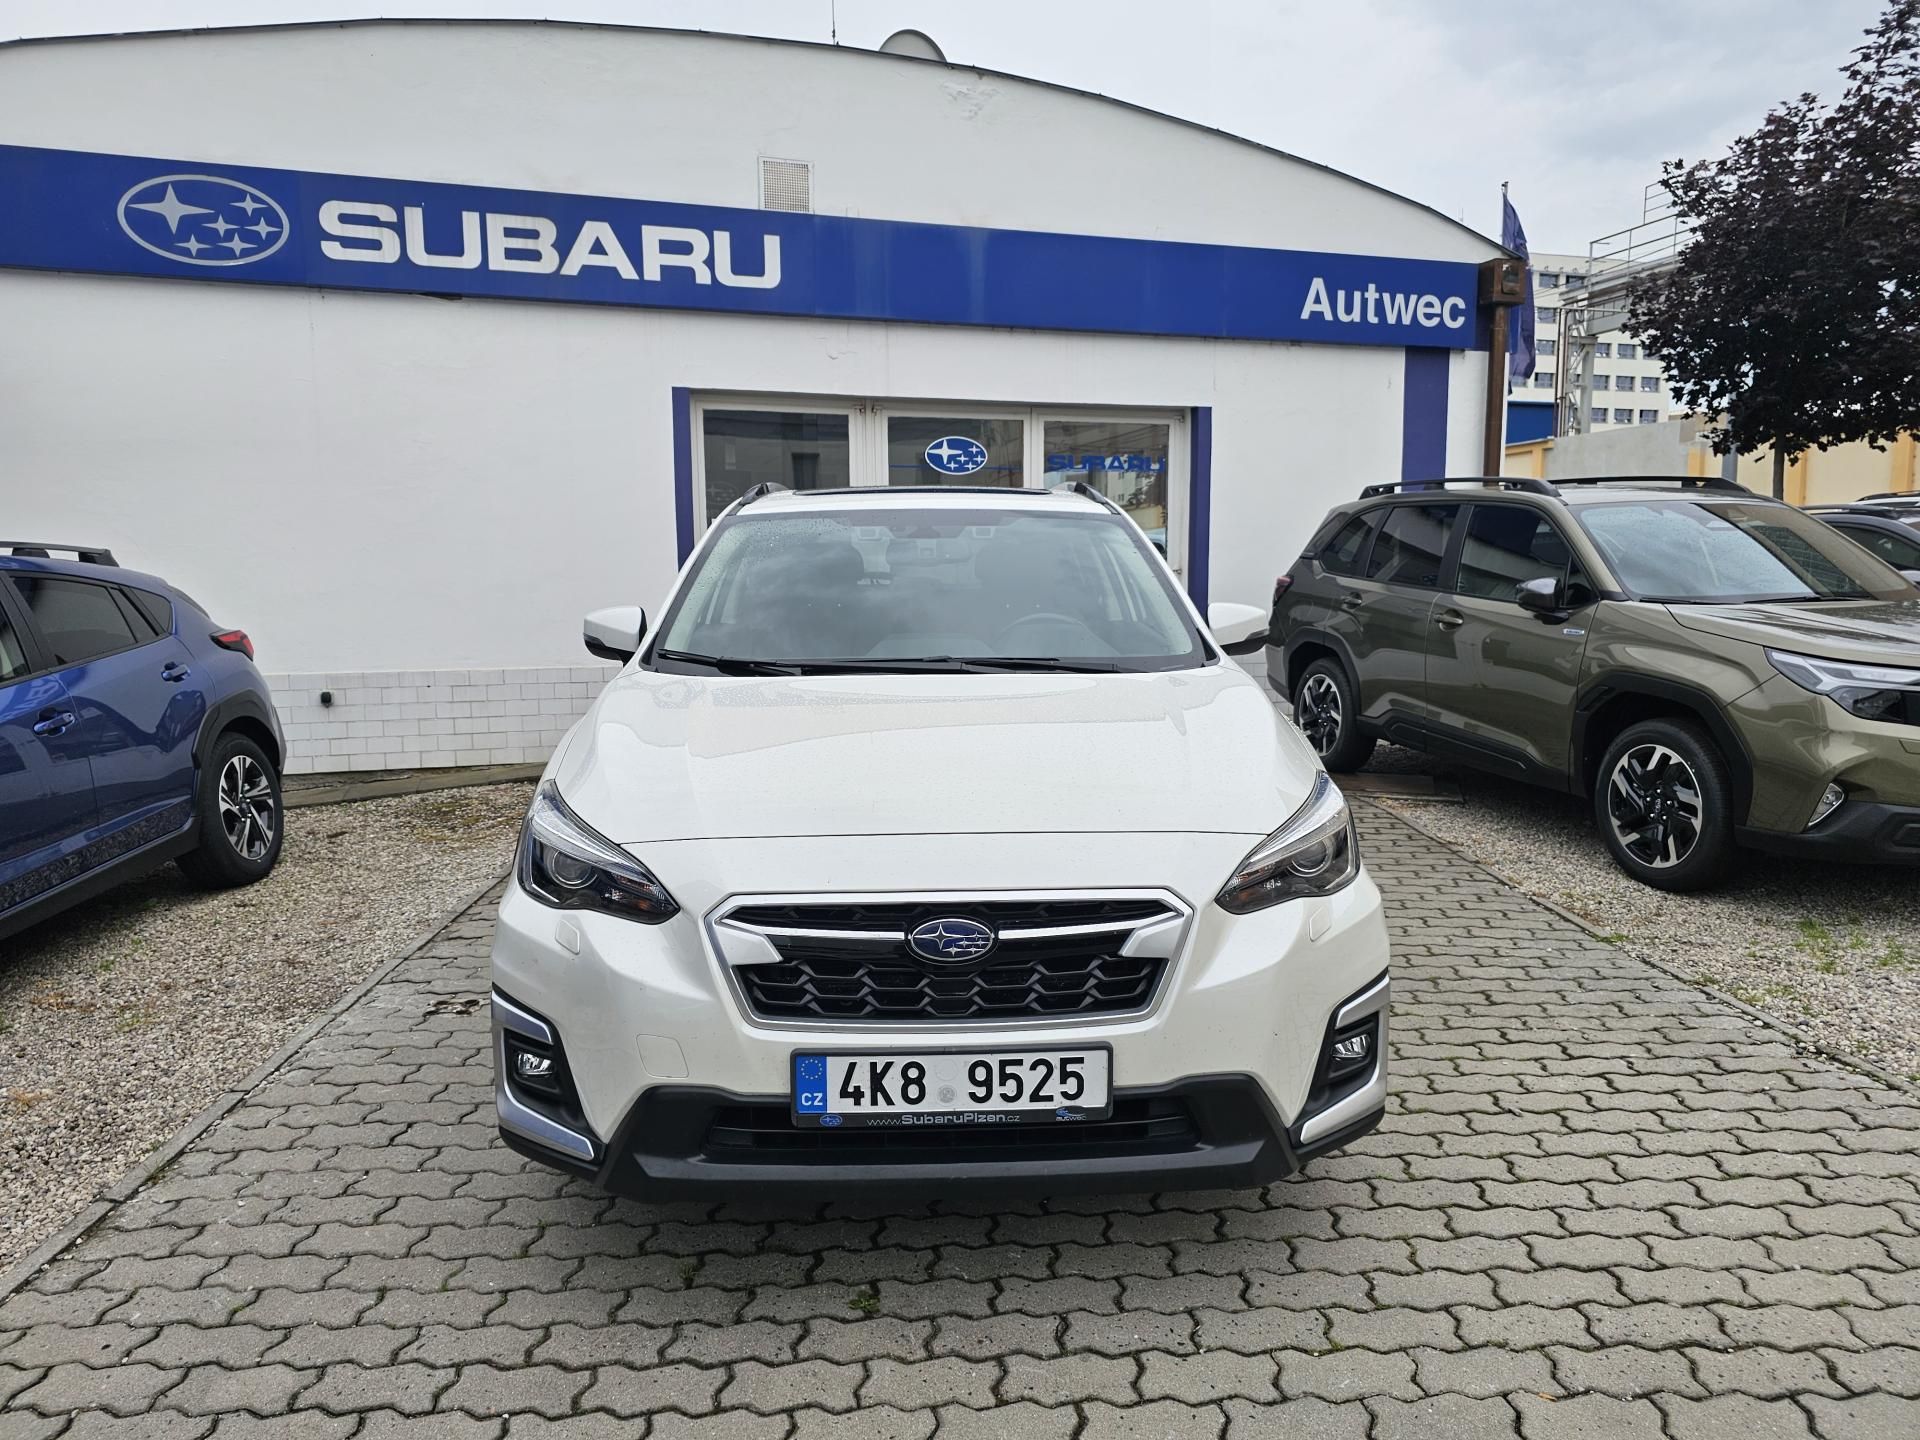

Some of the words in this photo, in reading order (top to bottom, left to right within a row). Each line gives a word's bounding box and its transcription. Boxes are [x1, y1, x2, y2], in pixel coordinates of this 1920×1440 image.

[319, 200, 781, 289] SUBARU
[1301, 277, 1466, 329] Autwec
[1047, 454, 1166, 473] SUBARU
[839, 1061, 926, 1106] 4K8
[968, 1057, 1085, 1103] 9525
[801, 1092, 823, 1106] CZ
[866, 1112, 1020, 1126] www.SubaruPlzen.cz
